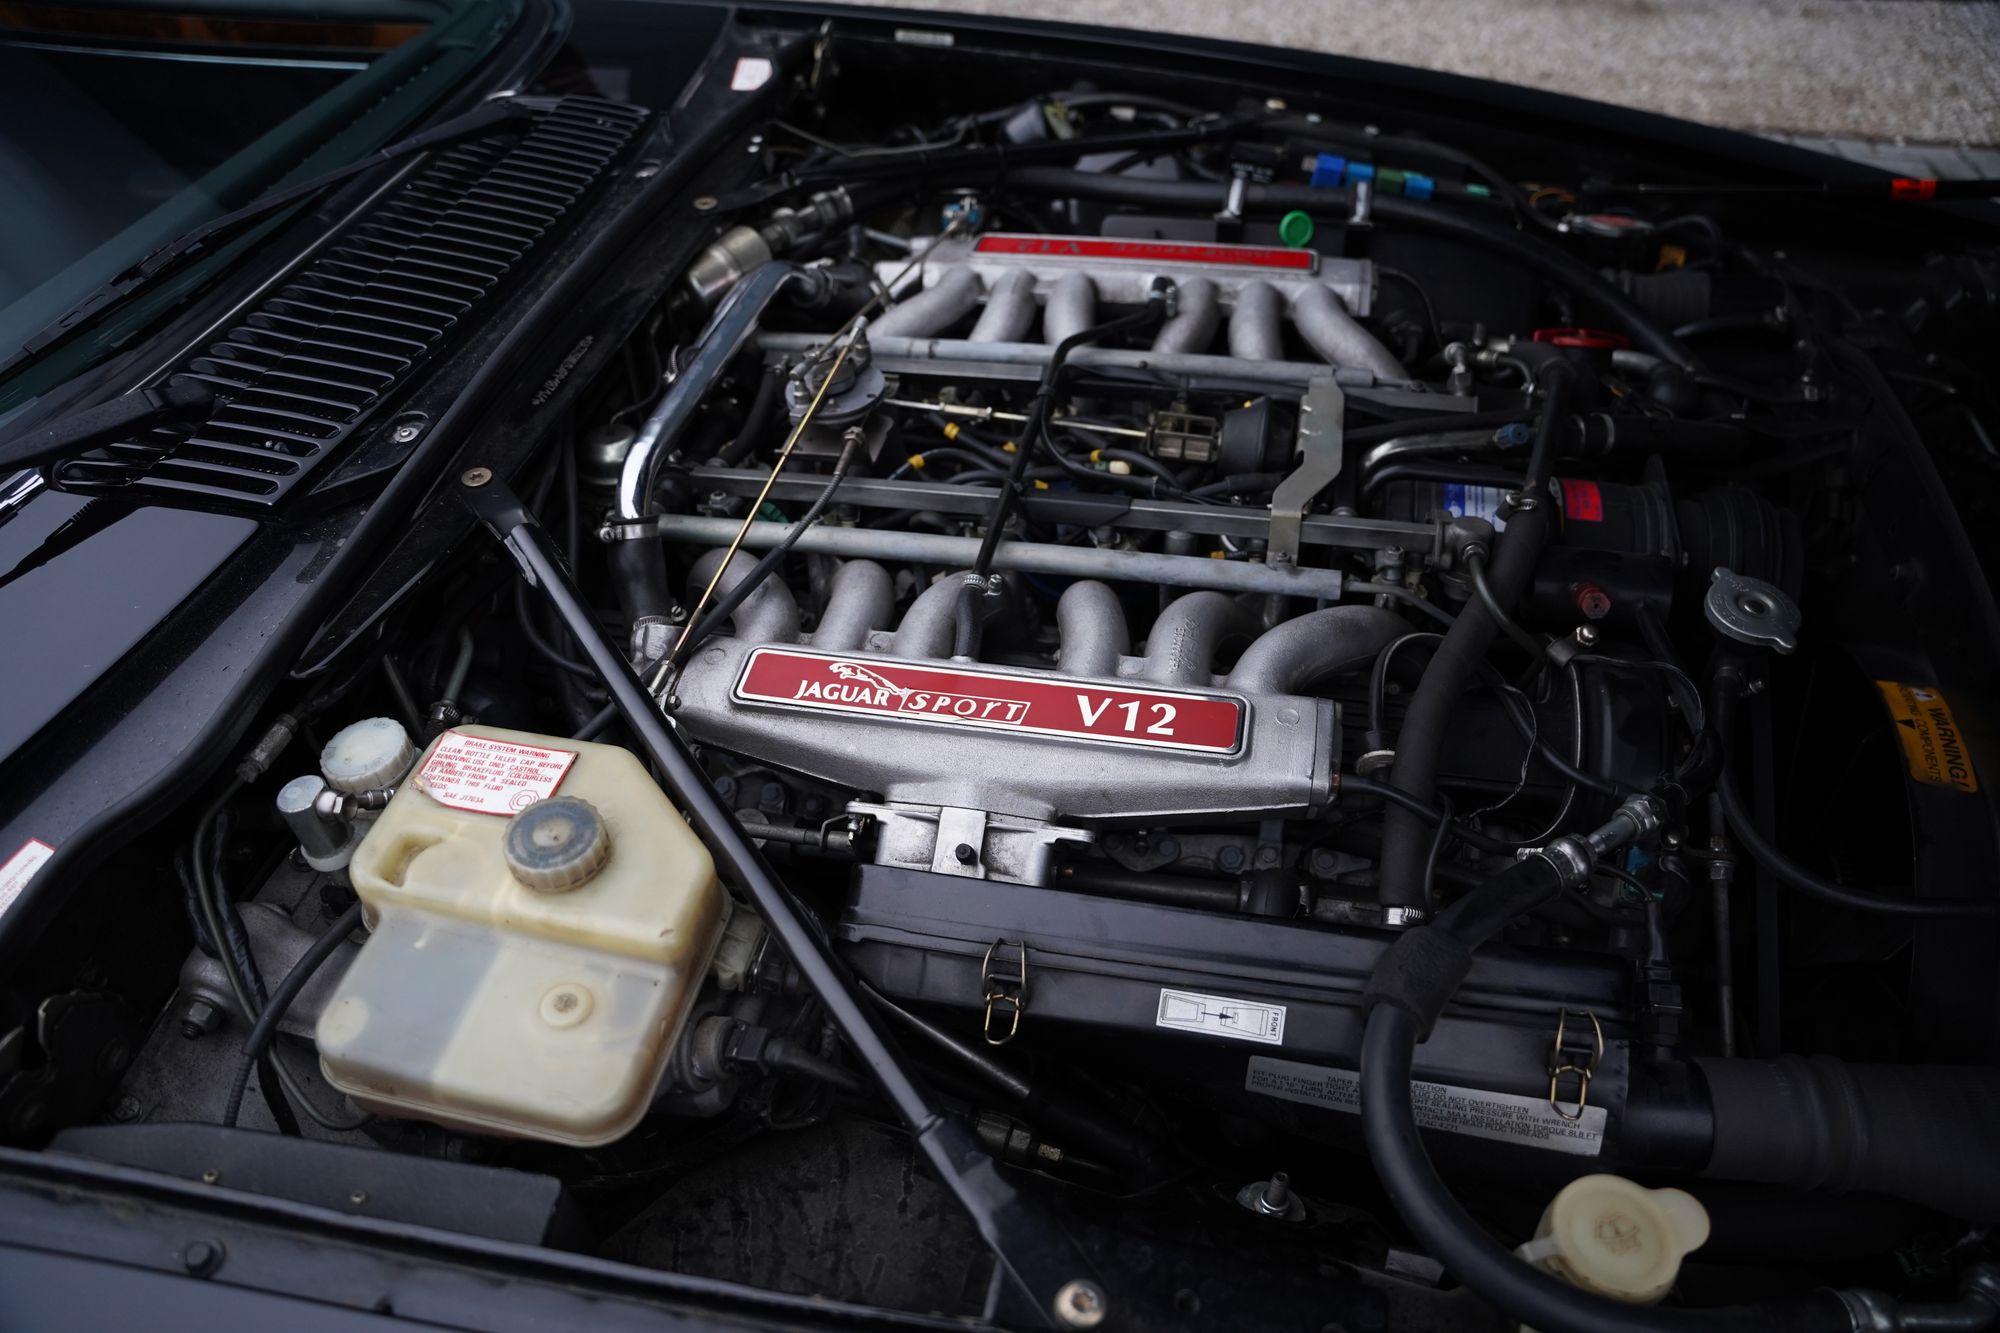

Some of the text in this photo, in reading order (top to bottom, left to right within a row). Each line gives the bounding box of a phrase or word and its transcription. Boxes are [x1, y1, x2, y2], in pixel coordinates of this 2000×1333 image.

[793, 680, 890, 707] JAGUAR
[1077, 694, 1177, 736] V12
[440, 746, 462, 755] CLEAN
[465, 750, 490, 759] BOTTLE
[495, 755, 517, 763] FILLER
[538, 762, 564, 770] BEFORE
[489, 744, 517, 752] SYSTEM
[519, 749, 551, 758] WARNING
[462, 765, 504, 776] BRAKEFLUID
[489, 761, 505, 769] ONLY
[501, 778, 527, 786] SEALED
[443, 792, 458, 800] SAE
[1269, 1011, 1280, 1037] FRONT
[1431, 1101, 1467, 1112] SEALING
[1470, 1106, 1512, 1119] PRESSURE
[1516, 1114, 1538, 1123] WITH
[1542, 1118, 1580, 1129] WRENCH
[1450, 1095, 1465, 1104] NOT
[1468, 1099, 1529, 1114] OVERTIGHTEN
[1411, 1105, 1443, 1114] ONTACT
[1470, 1114, 1530, 1129] INSTALLATION
[1533, 1124, 1566, 1135] TORQUE
[1416, 1112, 1457, 1124] CYLINDER
[1459, 1119, 1483, 1128] HEAD
[1485, 1123, 1507, 1133] PLUG
[1510, 1126, 1549, 1140] THREADS
